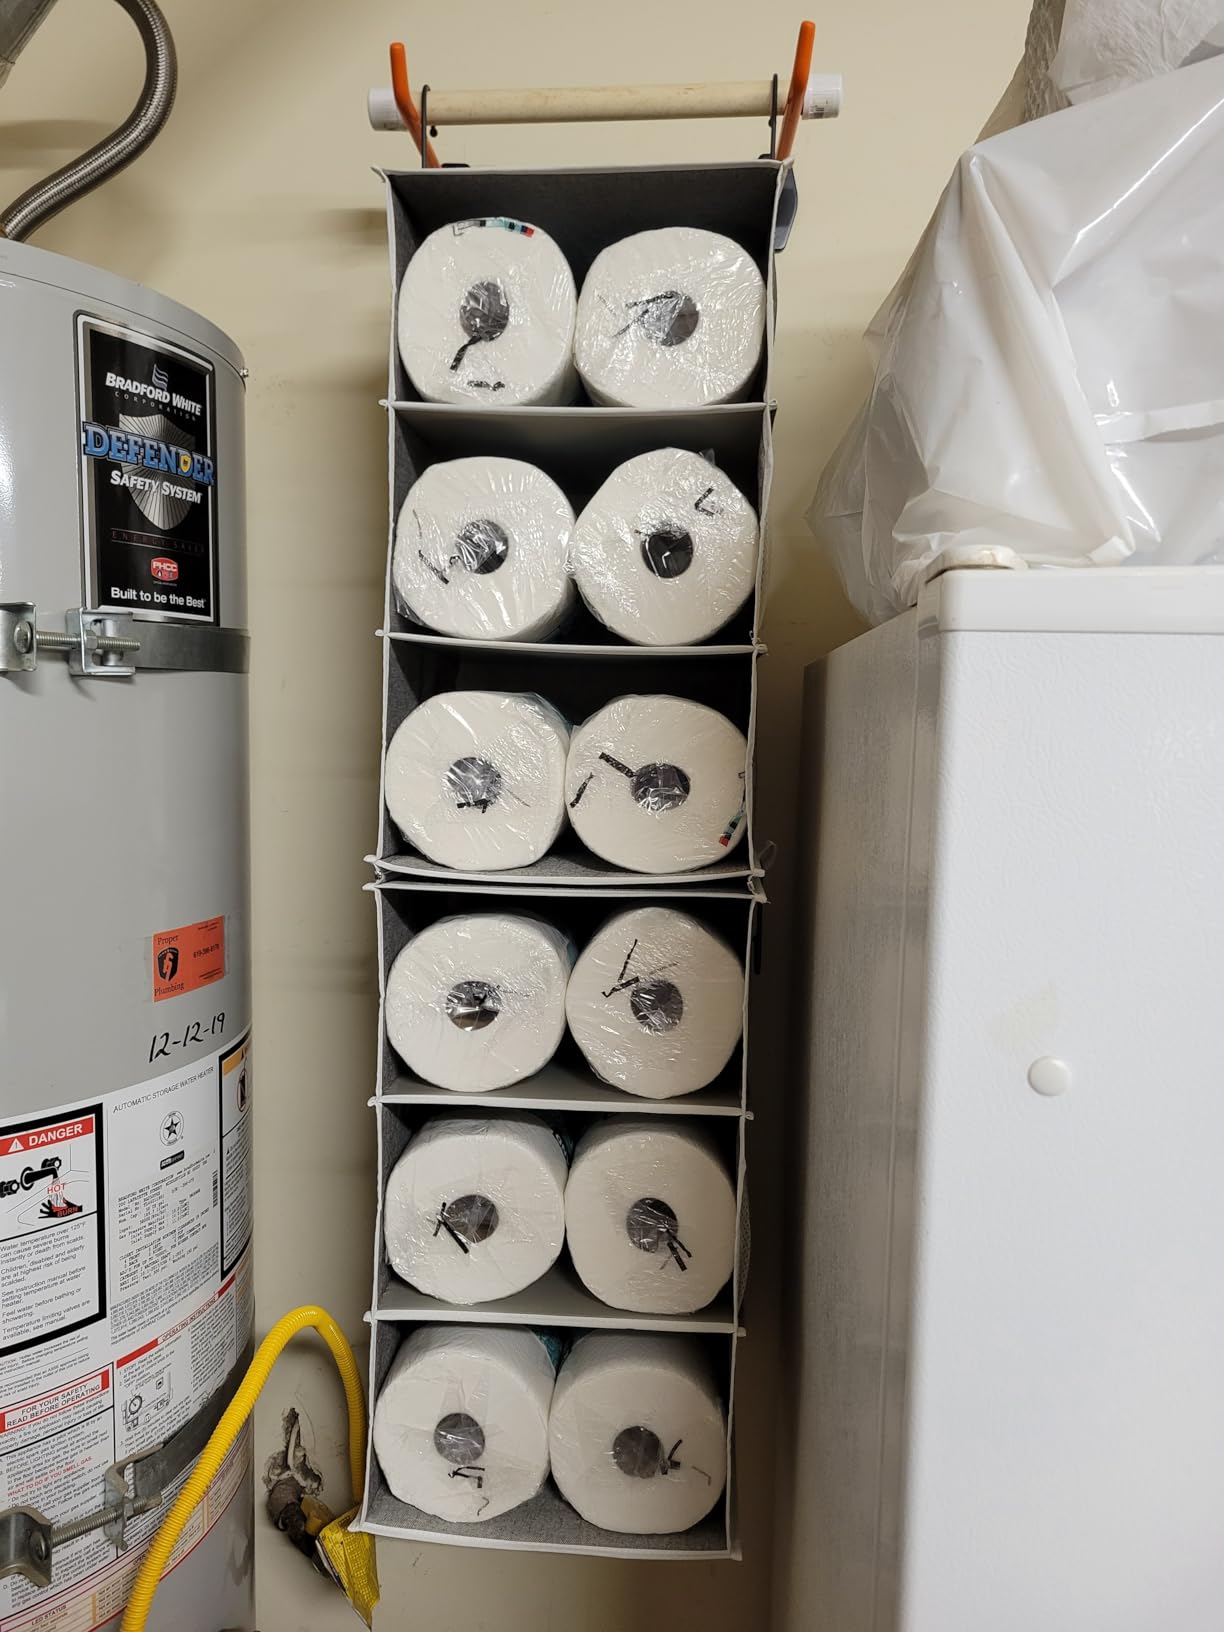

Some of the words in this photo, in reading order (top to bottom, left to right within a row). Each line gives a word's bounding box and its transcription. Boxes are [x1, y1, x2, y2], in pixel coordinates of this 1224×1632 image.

[105, 372, 171, 403] BRADFORD
[172, 393, 202, 416] WHITE
[115, 391, 197, 422] CORPORATION
[83, 423, 215, 485] DEFENDER
[110, 470, 160, 493] SAFETY
[161, 481, 201, 504] SYSTEM
[152, 561, 177, 572] PHCC
[111, 587, 138, 601] Built
[139, 591, 152, 602] to
[154, 592, 168, 604] be
[169, 594, 184, 605] the
[186, 596, 206, 608] Best
[157, 934, 179, 946] Proper
[154, 982, 184, 997] Plumbing
[149, 1012, 225, 1063] 12-12-19
[113, 1094, 151, 1113] AUTOMATIC
[152, 1083, 179, 1099] STORAGE
[180, 1075, 197, 1088] WATER
[198, 1066, 214, 1080] HEATER
[28, 1123, 83, 1146] DANGER
[47, 1183, 65, 1195] HOT
[57, 1205, 78, 1217] BURN
[7, 1416, 27, 1427] READ
[30, 1403, 59, 1418] BEFORE
[62, 1385, 100, 1406] OPERATING
[21, 1406, 36, 1415] FOR
[40, 1397, 59, 1408] YOUR
[61, 1384, 87, 1399] SAFETY
